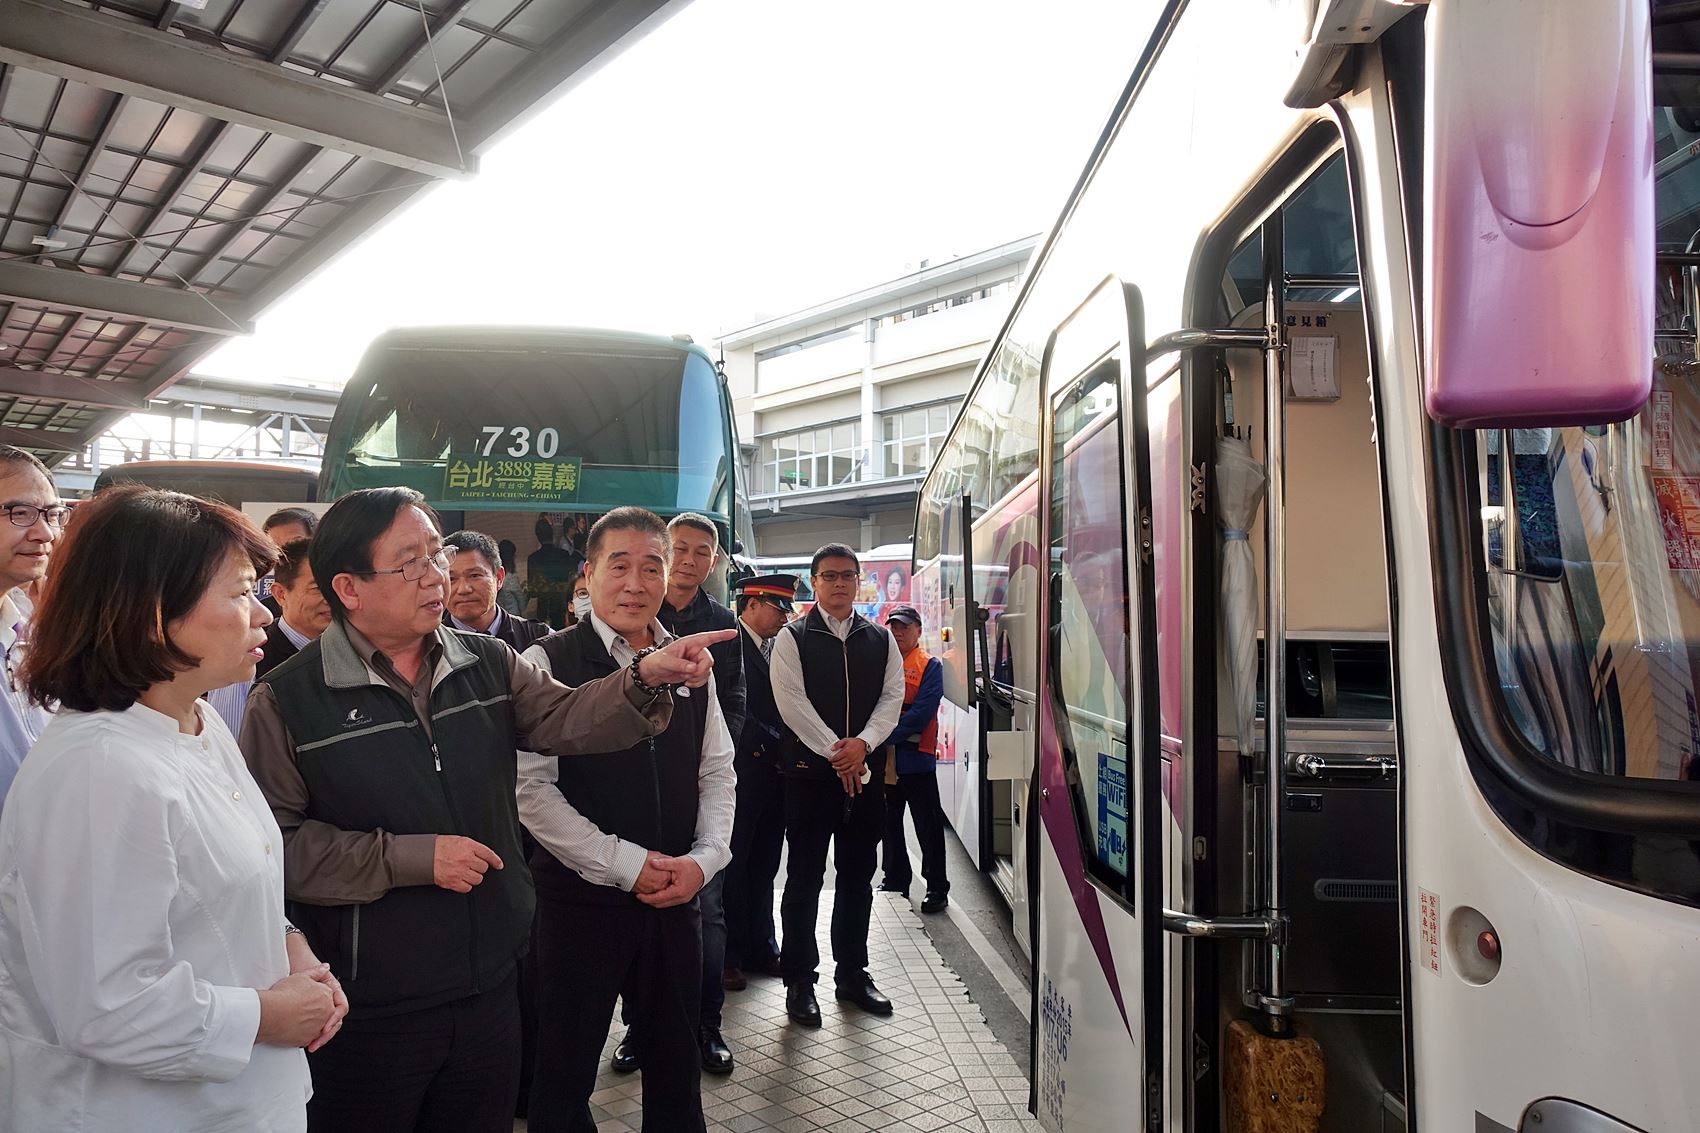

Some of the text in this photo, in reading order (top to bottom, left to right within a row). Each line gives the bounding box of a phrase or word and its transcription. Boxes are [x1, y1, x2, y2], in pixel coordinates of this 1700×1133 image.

[1287, 315, 1327, 327] 意見箱
[482, 426, 559, 459] 730
[449, 460, 577, 491] 台北 3888 嘉義
[491, 491, 529, 499] TAICHUNG
[1656, 479, 1681, 558] 滅火器
[1108, 781, 1126, 808] WiFi
